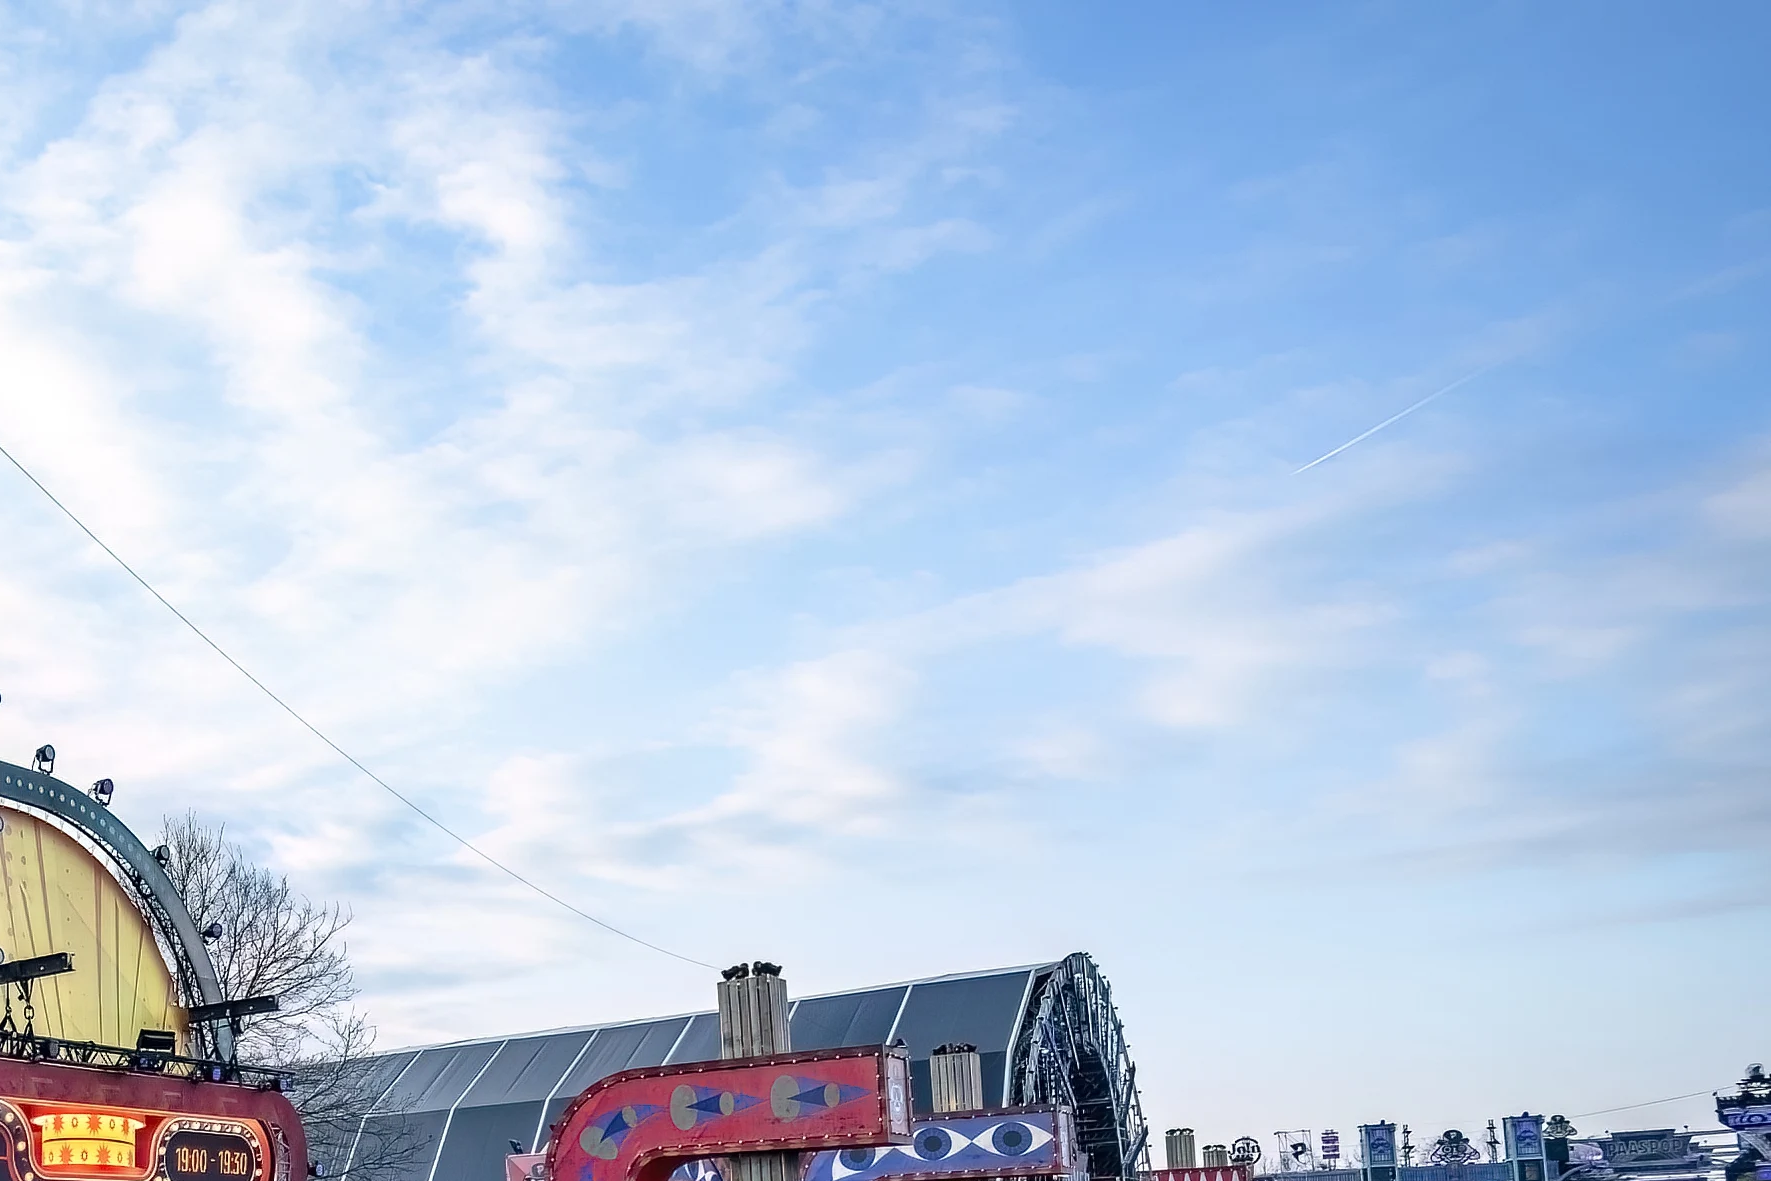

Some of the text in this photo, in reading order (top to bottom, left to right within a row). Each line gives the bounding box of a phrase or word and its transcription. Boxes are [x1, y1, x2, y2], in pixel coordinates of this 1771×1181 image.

[1606, 1138, 1683, 1157] PAASPOP
[175, 1147, 207, 1173] 19:00
[218, 1150, 248, 1175] 19:30
